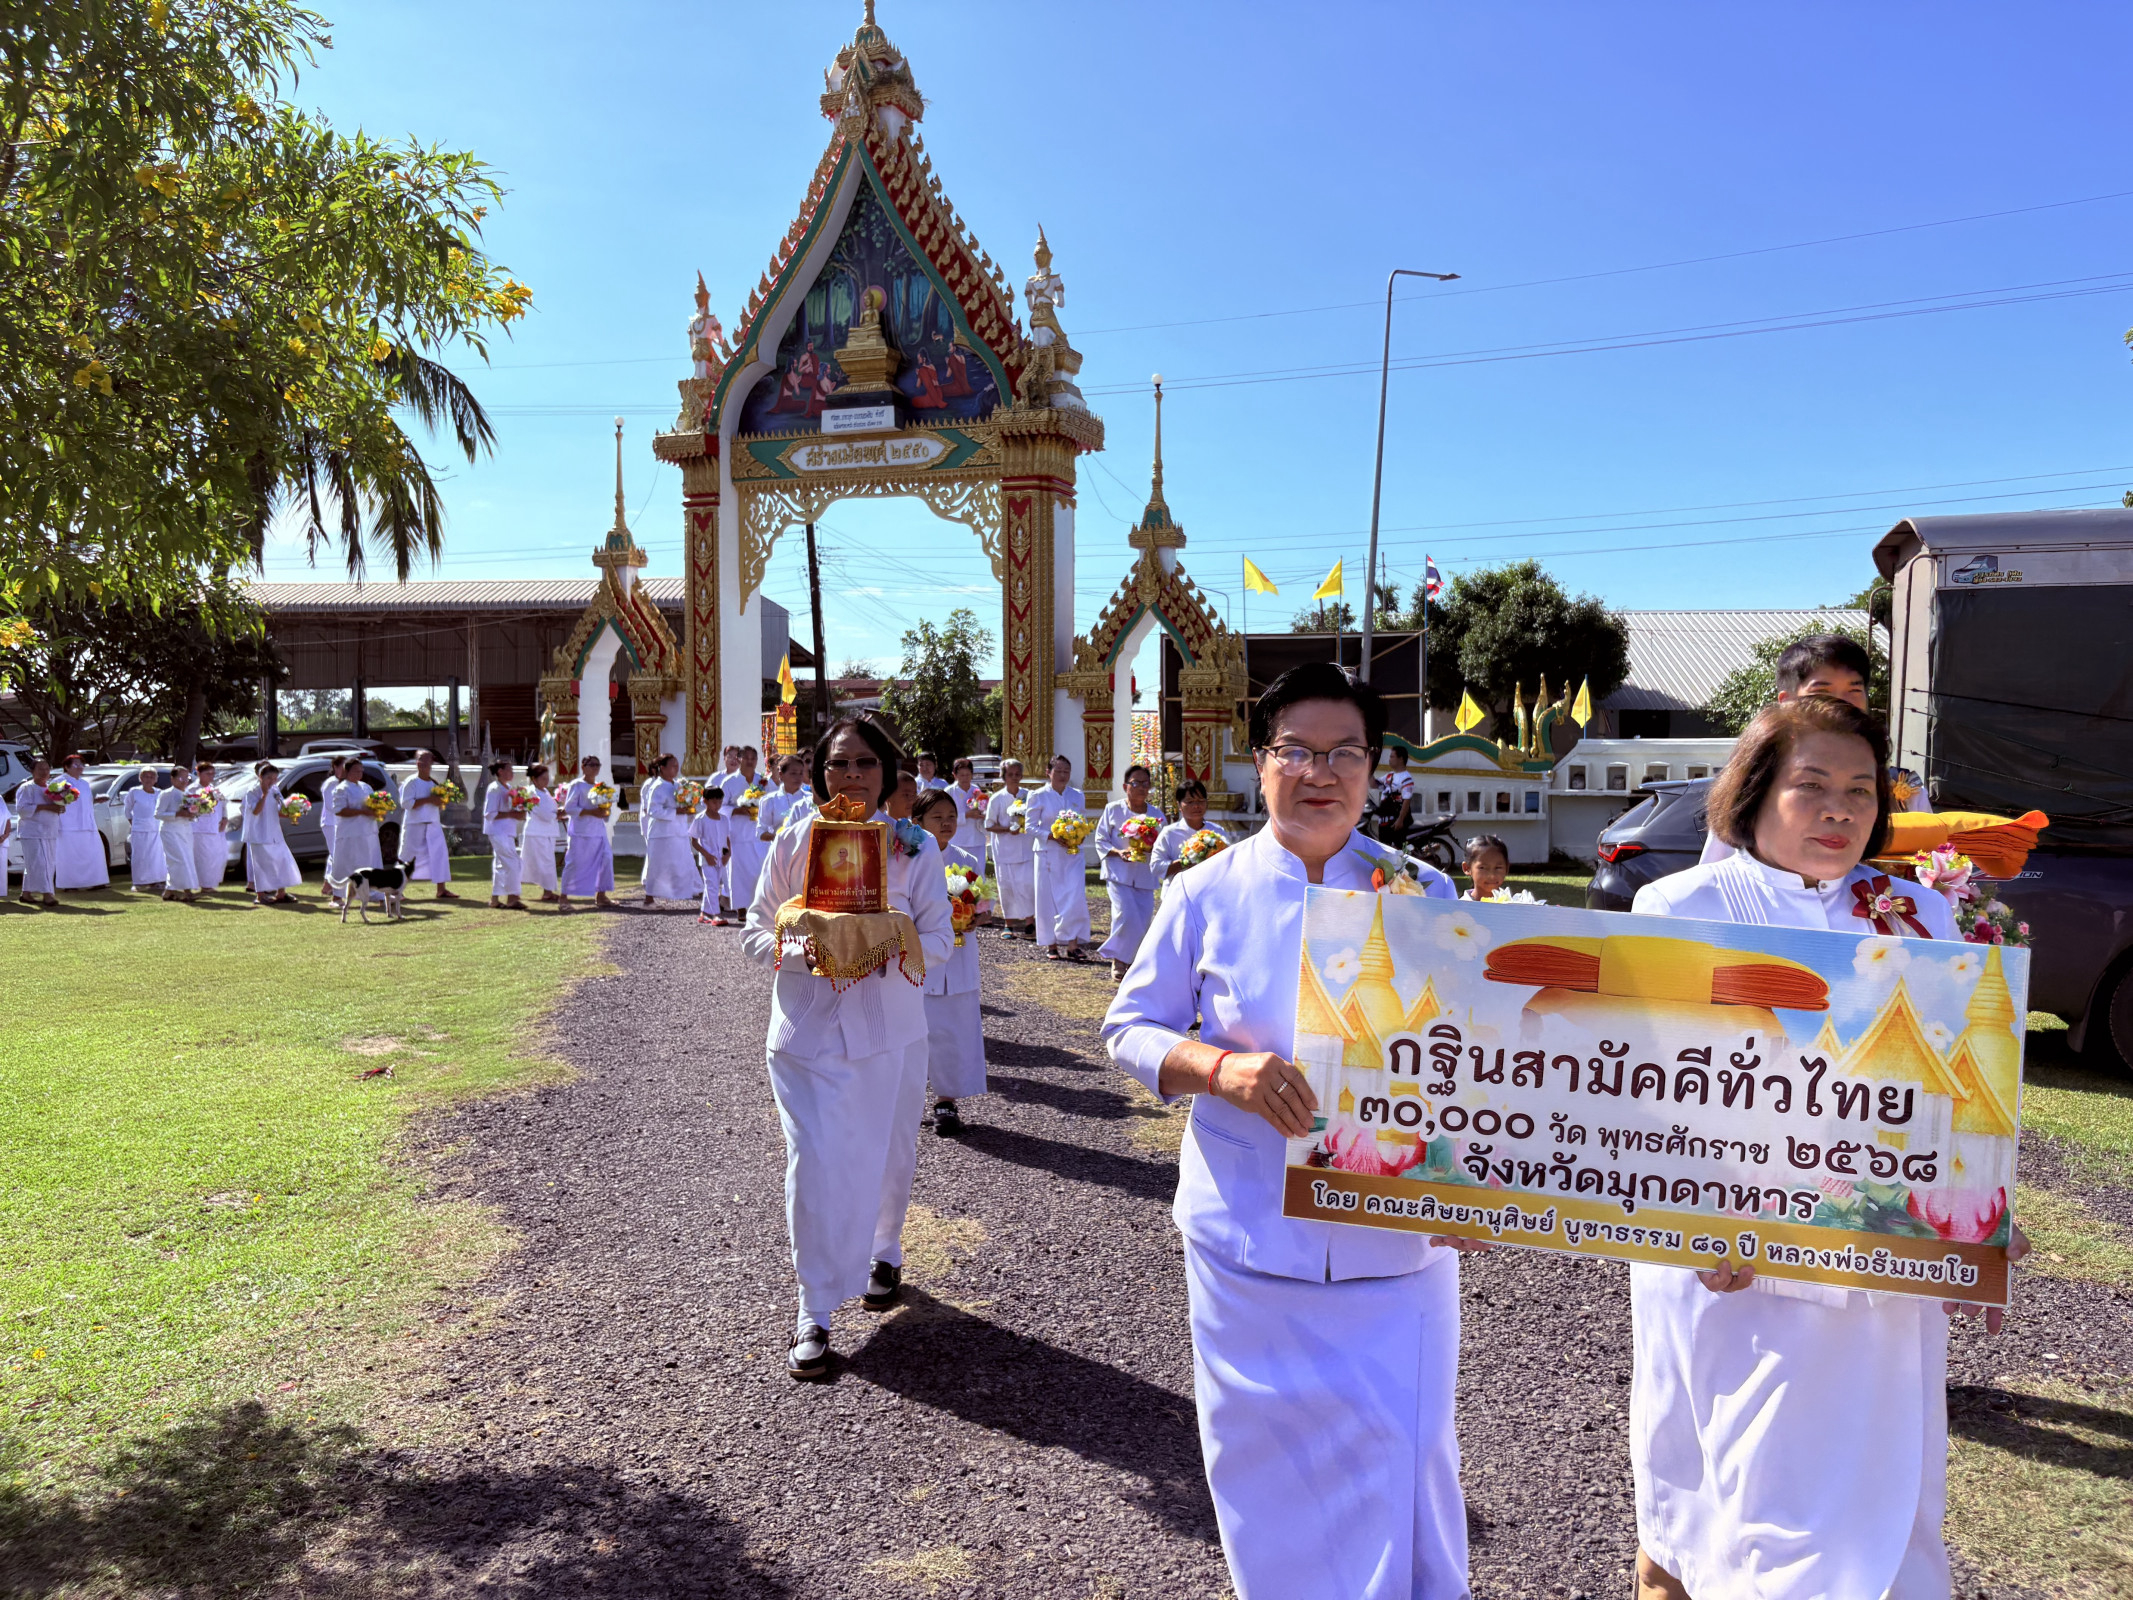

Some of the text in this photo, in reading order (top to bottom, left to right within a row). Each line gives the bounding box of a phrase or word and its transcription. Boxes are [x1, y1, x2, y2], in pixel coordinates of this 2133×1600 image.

[1389, 1024, 1914, 1125] กฐินสามัคคีทั่วไทย
[1360, 1096, 1938, 1183] ๓๐,๐๐๐ วัด พุทธศักราช ๒๕๖๘
[1463, 1142, 1820, 1219] จังหวัดมุกดาหาร
[1314, 1183, 1976, 1284] โดย คณะศิษยานุศิษย์ บูชาธรรม ๘๑ ปี หลวงพ่อธัมมชโย
